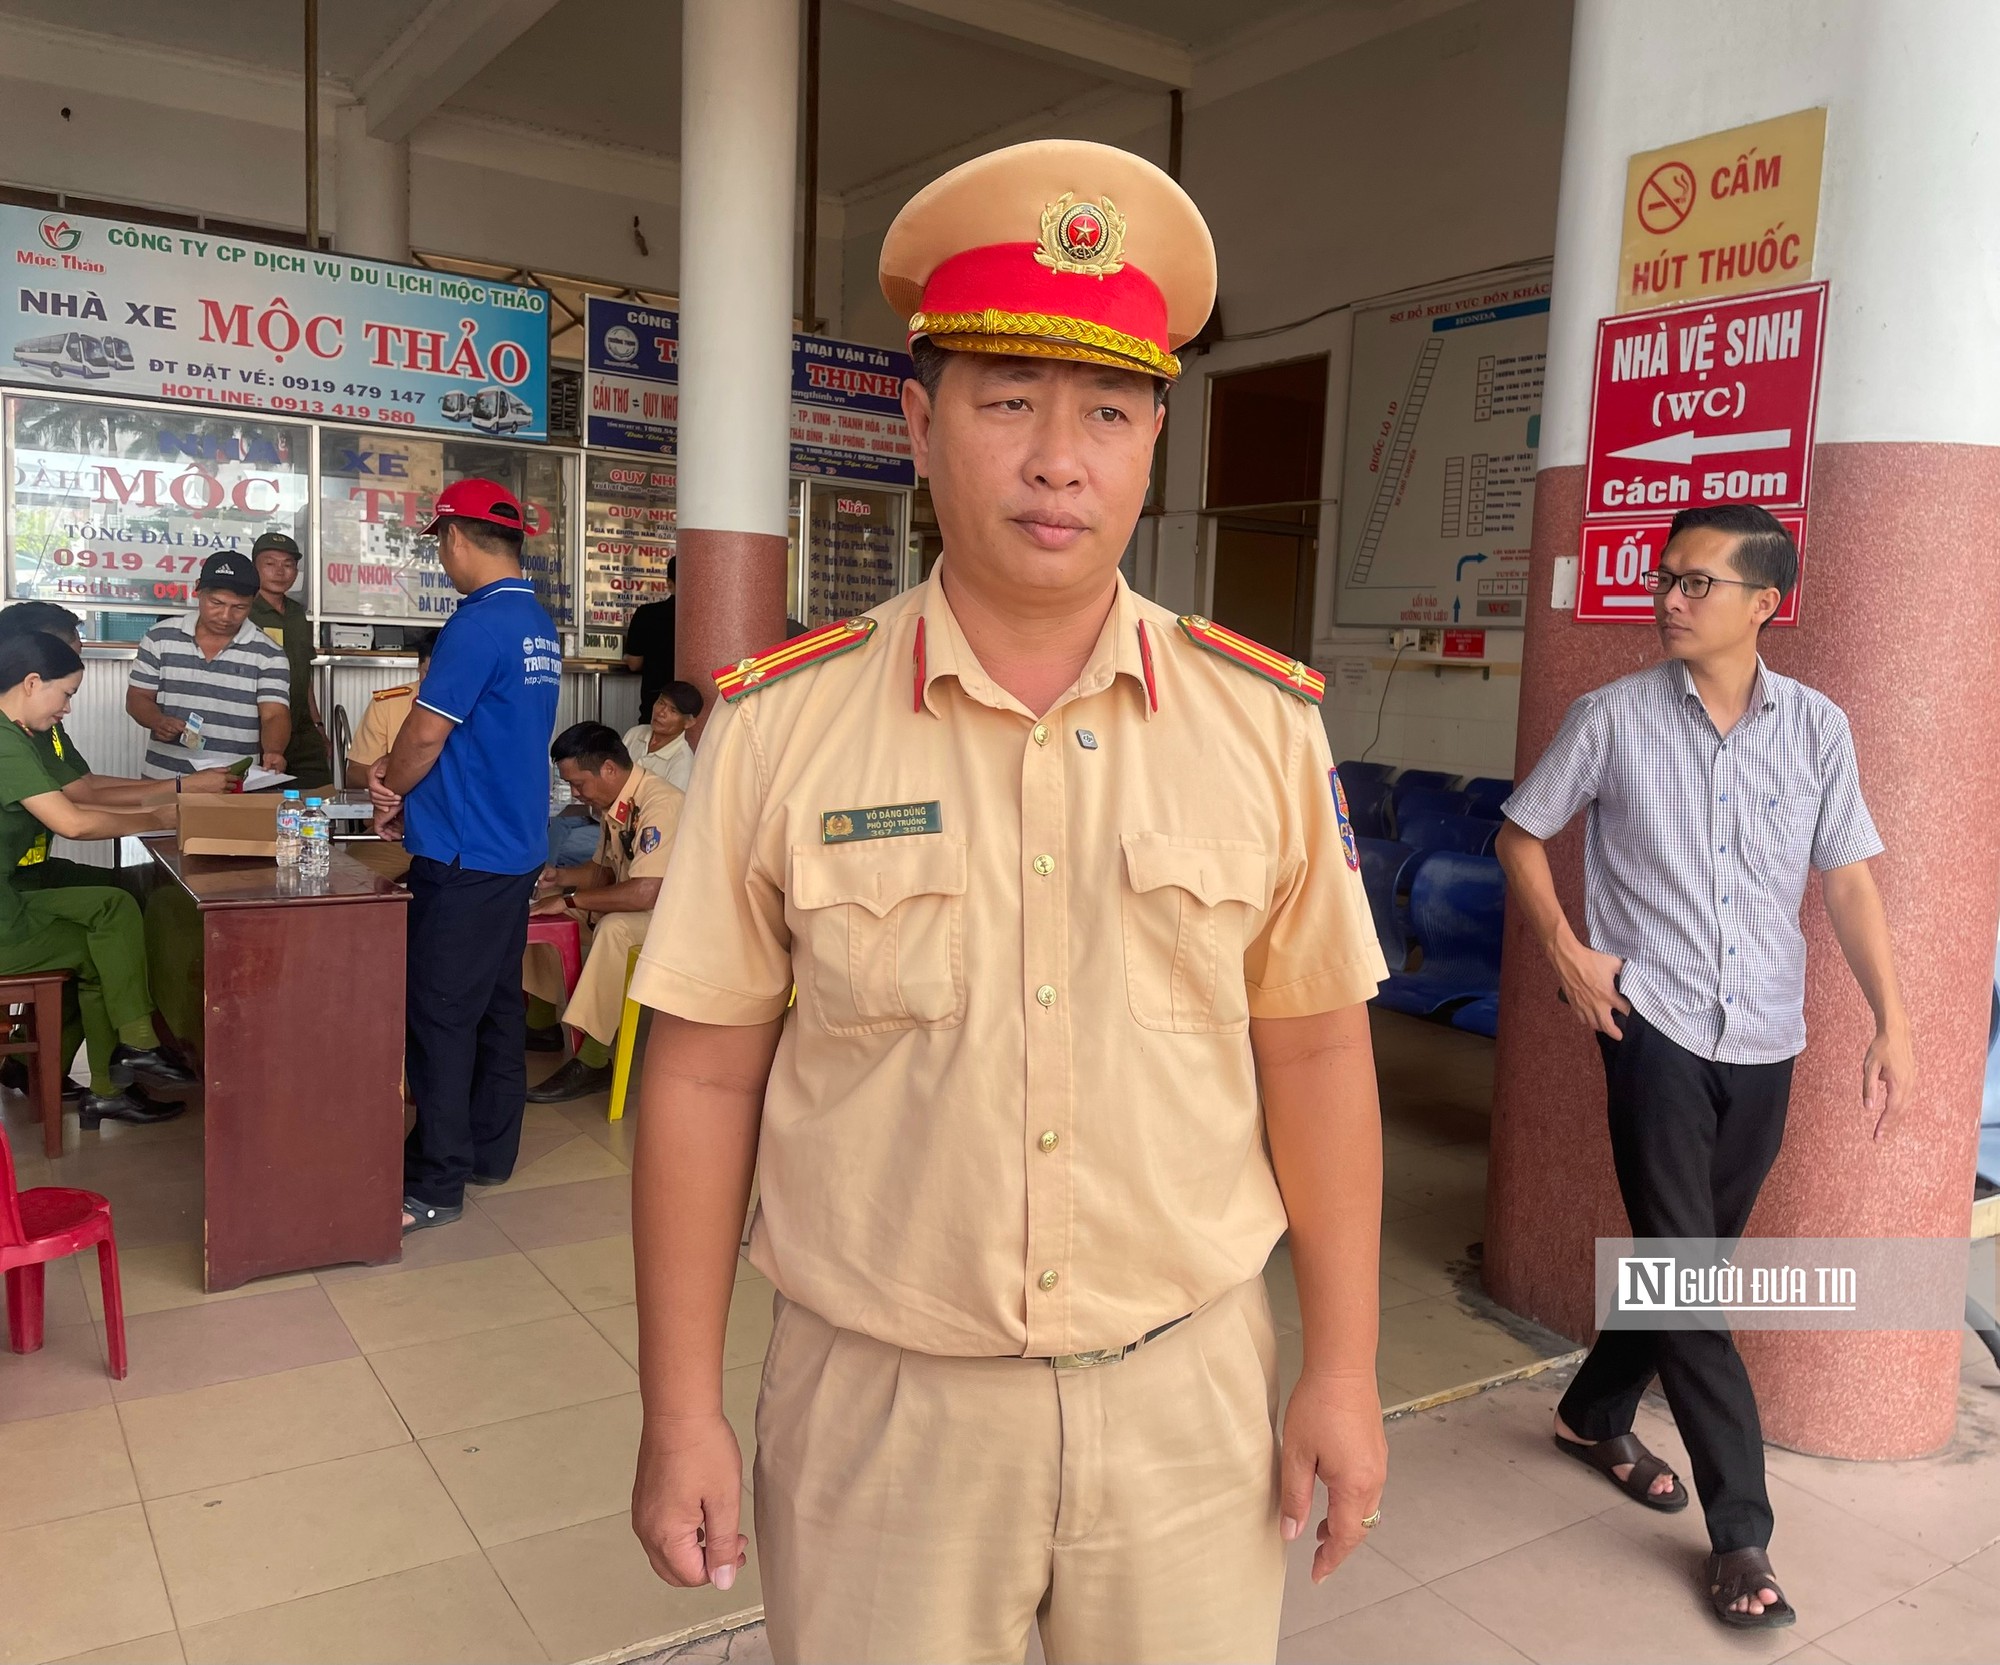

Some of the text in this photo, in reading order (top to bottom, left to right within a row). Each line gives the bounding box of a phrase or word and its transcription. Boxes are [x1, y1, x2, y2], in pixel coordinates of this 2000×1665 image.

[1711, 147, 1781, 200] CẤM
[108, 226, 542, 312] CÔNG TY CP DỊCH VỤ DU LỊCH MỘC THẢO
[1632, 221, 1800, 296] HÚT THUỐC
[1513, 283, 1550, 299] KHÁC
[627, 311, 671, 329] CÔNG
[1455, 311, 1496, 326] HONDA
[20, 289, 528, 384] NHÀ XE MỘC THẢO
[1611, 309, 1802, 382] NHÀ VỆ SINH
[149, 358, 426, 404] ĐT ĐẶT VÉ: 0919 479 147
[806, 363, 900, 399] THỊNH
[162, 383, 415, 424] HOTLINE: 0913 419 580
[643, 392, 660, 419] QUY
[661, 394, 678, 421] NHƠ
[1652, 381, 1746, 427] (WC)
[341, 450, 409, 477] XE
[610, 469, 646, 485] QUY
[91, 462, 280, 519] MỘC
[1603, 470, 1787, 506] Cách 50m
[608, 506, 642, 519] QUY
[838, 499, 870, 517] Nhận
[64, 520, 133, 543] TỔNG
[194, 530, 240, 551] ĐẶT
[598, 542, 632, 555] QUY
[54, 548, 143, 571] 0919
[1596, 530, 1651, 586] LỐI
[328, 561, 393, 586] QUY NHƠN
[419, 572, 436, 588] TUY
[610, 578, 668, 592] QUY NH
[418, 594, 431, 612] ĐÀ
[1488, 603, 1510, 614] WC
[870, 825, 924, 837] 367 380
